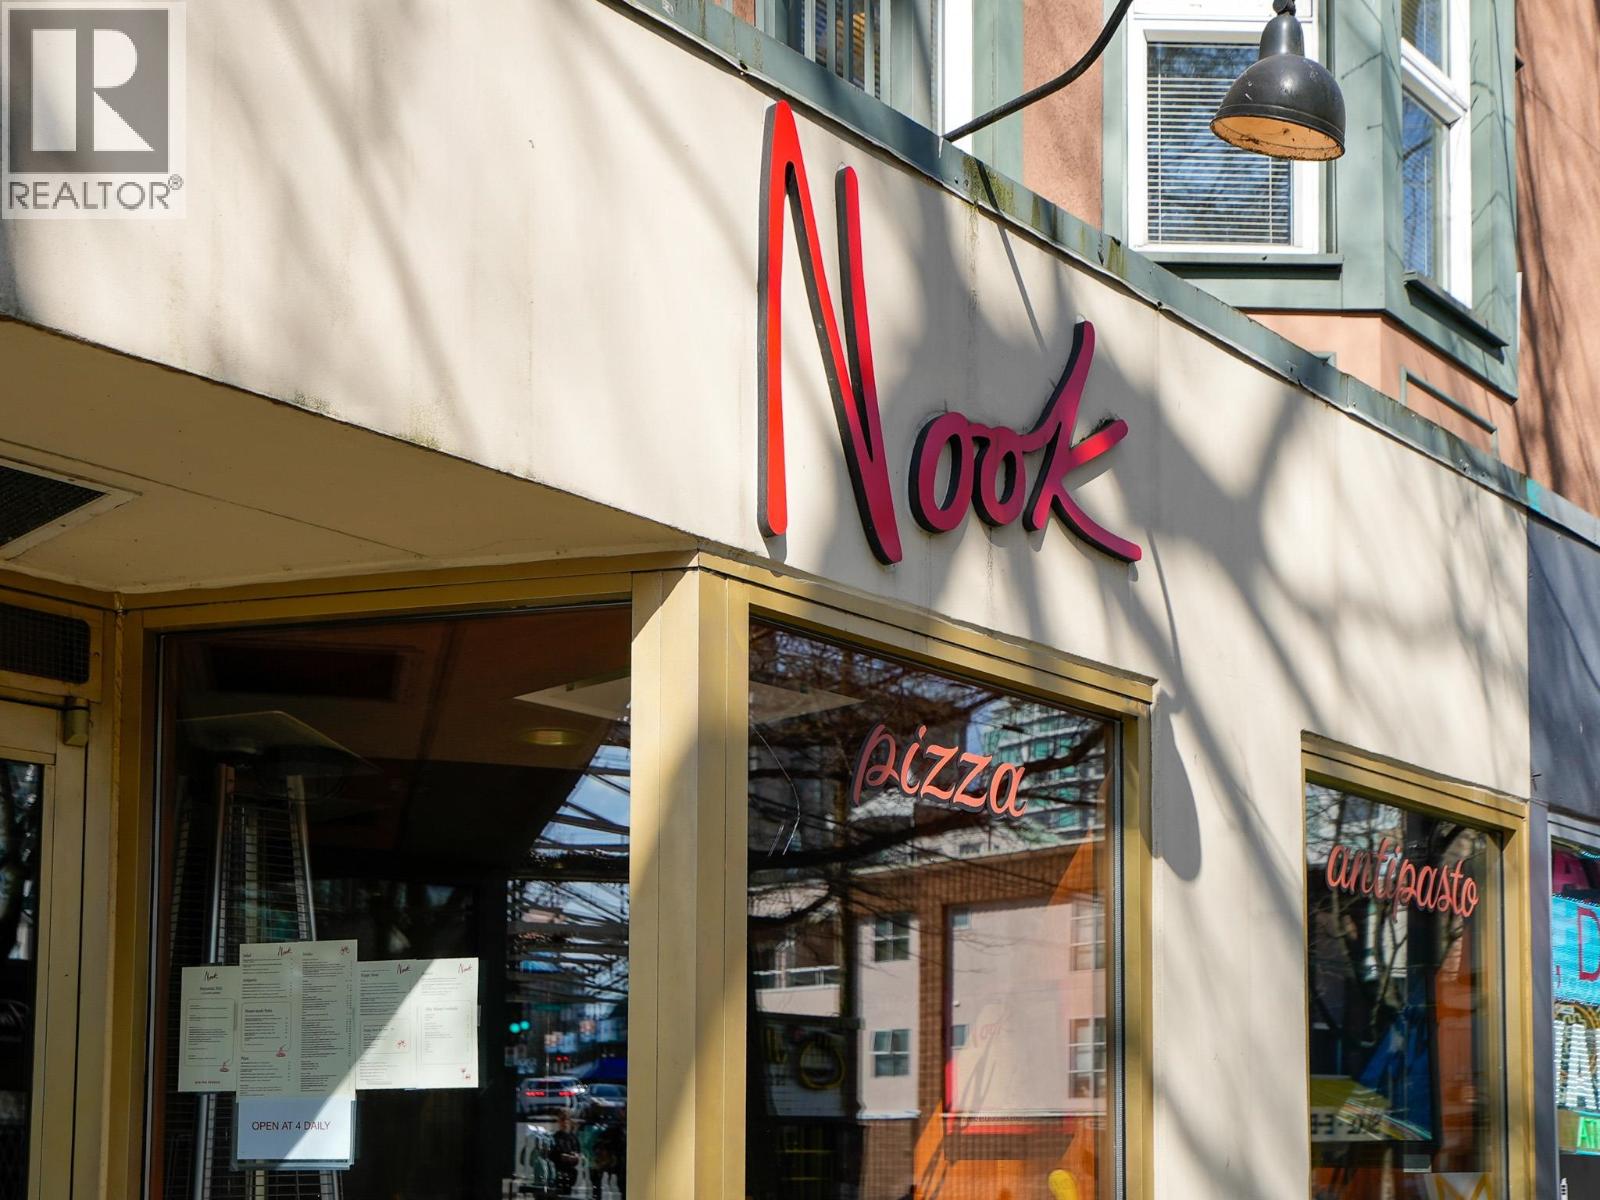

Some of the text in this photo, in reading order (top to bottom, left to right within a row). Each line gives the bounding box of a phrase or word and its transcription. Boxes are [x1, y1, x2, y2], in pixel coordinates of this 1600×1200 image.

[757, 99, 1142, 566] Nook
[852, 724, 1027, 817] pizza
[1327, 837, 1479, 921] antipasto
[251, 1121, 331, 1131] OPEN AT 4 DAILY
